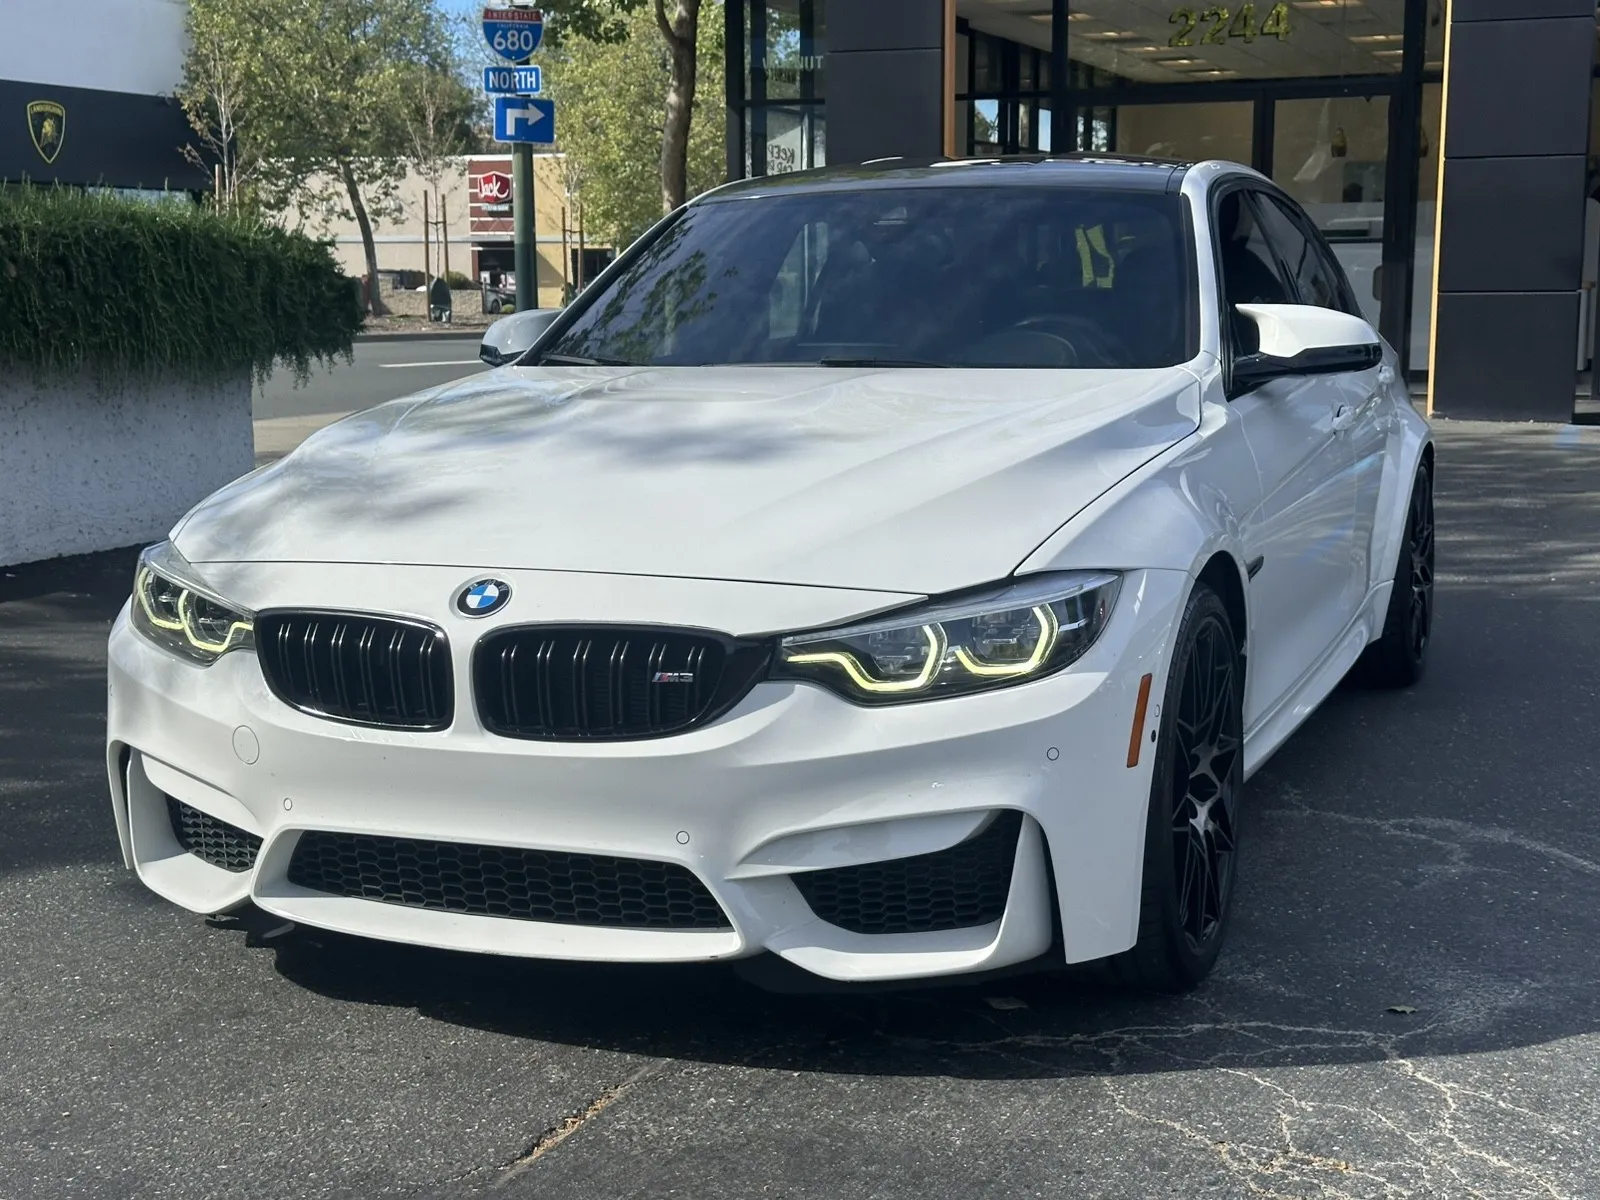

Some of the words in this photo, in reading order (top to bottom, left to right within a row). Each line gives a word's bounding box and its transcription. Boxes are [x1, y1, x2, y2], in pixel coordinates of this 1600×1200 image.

[488, 11, 537, 20] INTERSTATE
[1168, 3, 1290, 47] 2244
[493, 30, 533, 51] 680
[489, 71, 536, 89] NORTH
[480, 175, 509, 198] Jack
